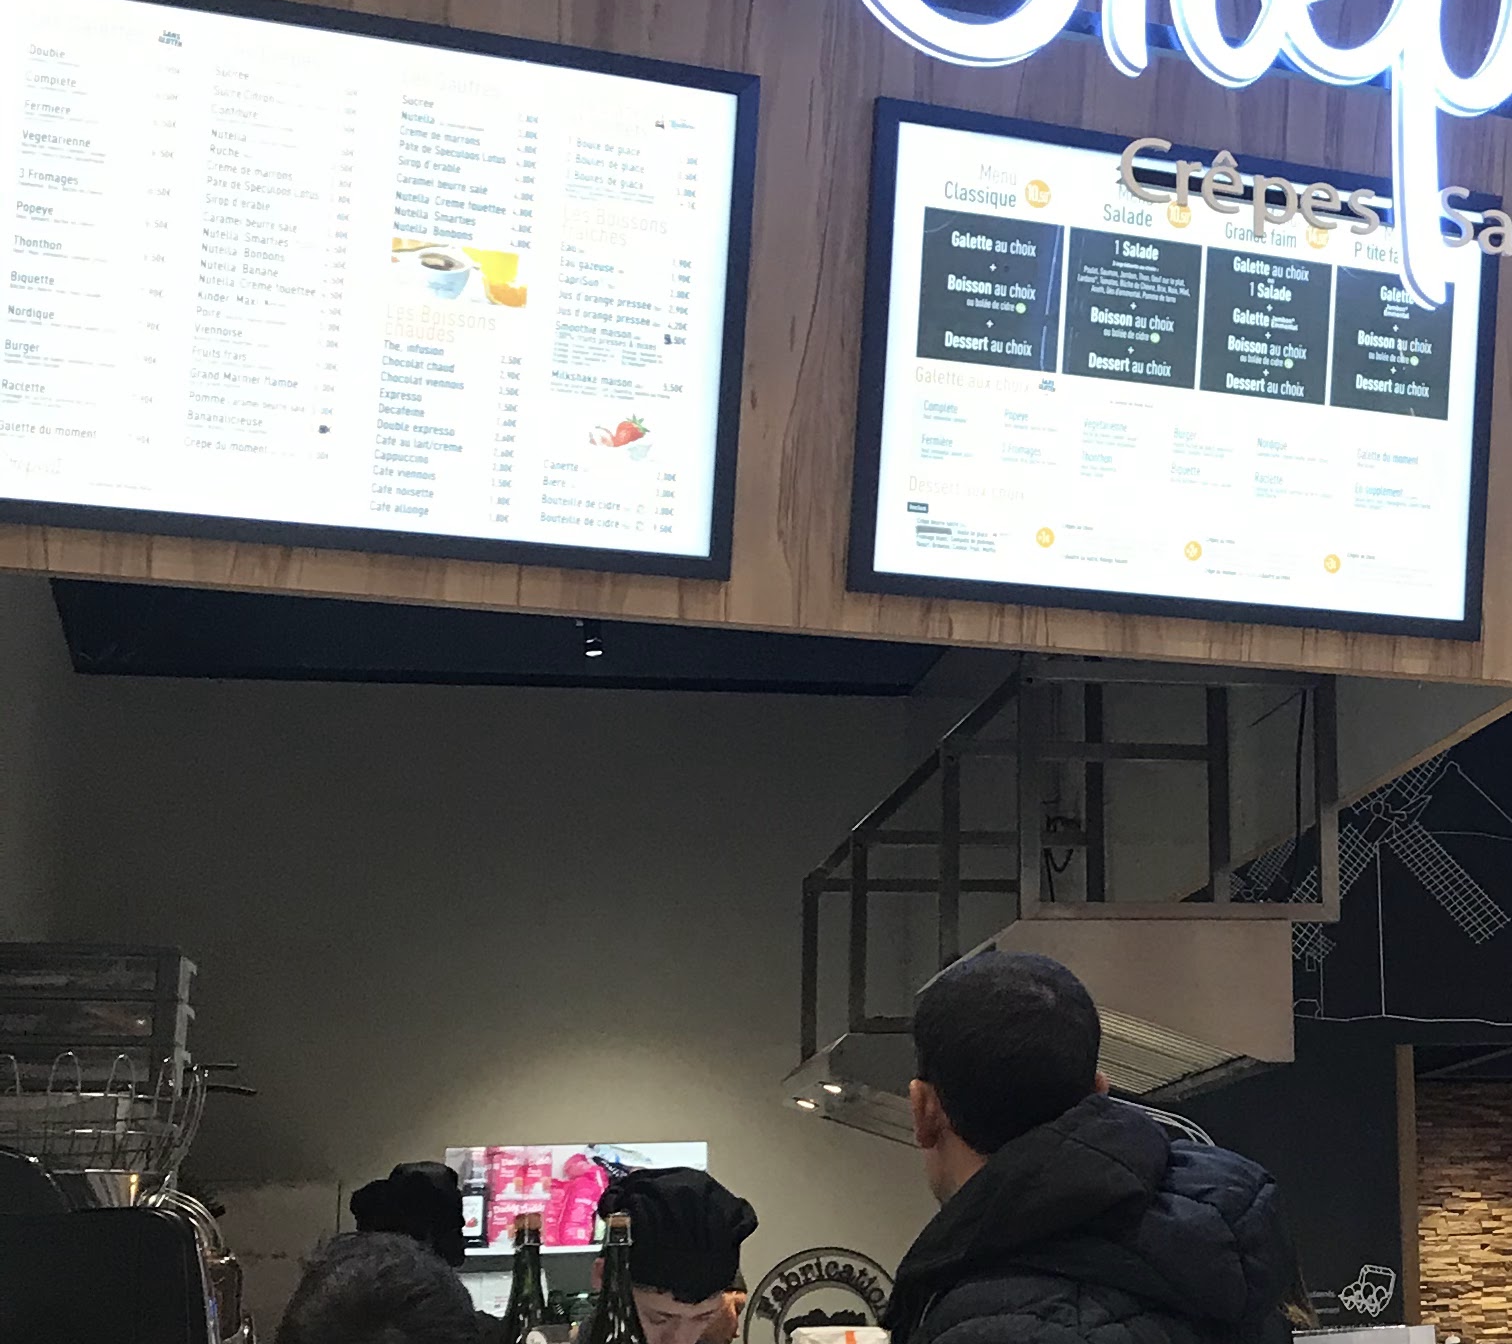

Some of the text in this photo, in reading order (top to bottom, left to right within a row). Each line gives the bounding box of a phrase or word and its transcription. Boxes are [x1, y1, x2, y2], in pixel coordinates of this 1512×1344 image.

[28, 170, 79, 187] Fromages
[1119, 136, 1383, 237] Crêpes
[945, 181, 1016, 209] Classique
[16, 201, 53, 216] Popeye
[1103, 204, 1152, 227] Salade
[14, 235, 62, 250] Thonthon
[951, 230, 1037, 257] Galette au choix
[1271, 230, 1297, 248] faim
[1115, 240, 1159, 260] 1 Salade
[10, 271, 54, 286] Biquette
[1233, 256, 1309, 281] Galette au choix
[947, 274, 1036, 300] Boisson au choix
[1250, 282, 1292, 302] 1 Salade
[8, 305, 54, 319] Nordique
[1090, 306, 1175, 332] Boisson au choix
[1233, 308, 1270, 327] Galette
[5, 339, 40, 354] Burger
[944, 331, 1032, 356] Dessert au choix
[1228, 335, 1307, 359] Boisson au choix
[1358, 330, 1432, 355] Boisson au choix
[382, 356, 424, 370] Chocolat
[1088, 352, 1172, 377] Dessert au choix
[381, 371, 422, 385] Chocolat
[915, 366, 964, 387] Galette
[1226, 373, 1305, 397] Dessert au choix
[1355, 374, 1430, 398] Dessert au choix
[380, 388, 422, 403] Expresso
[377, 418, 409, 432] Double
